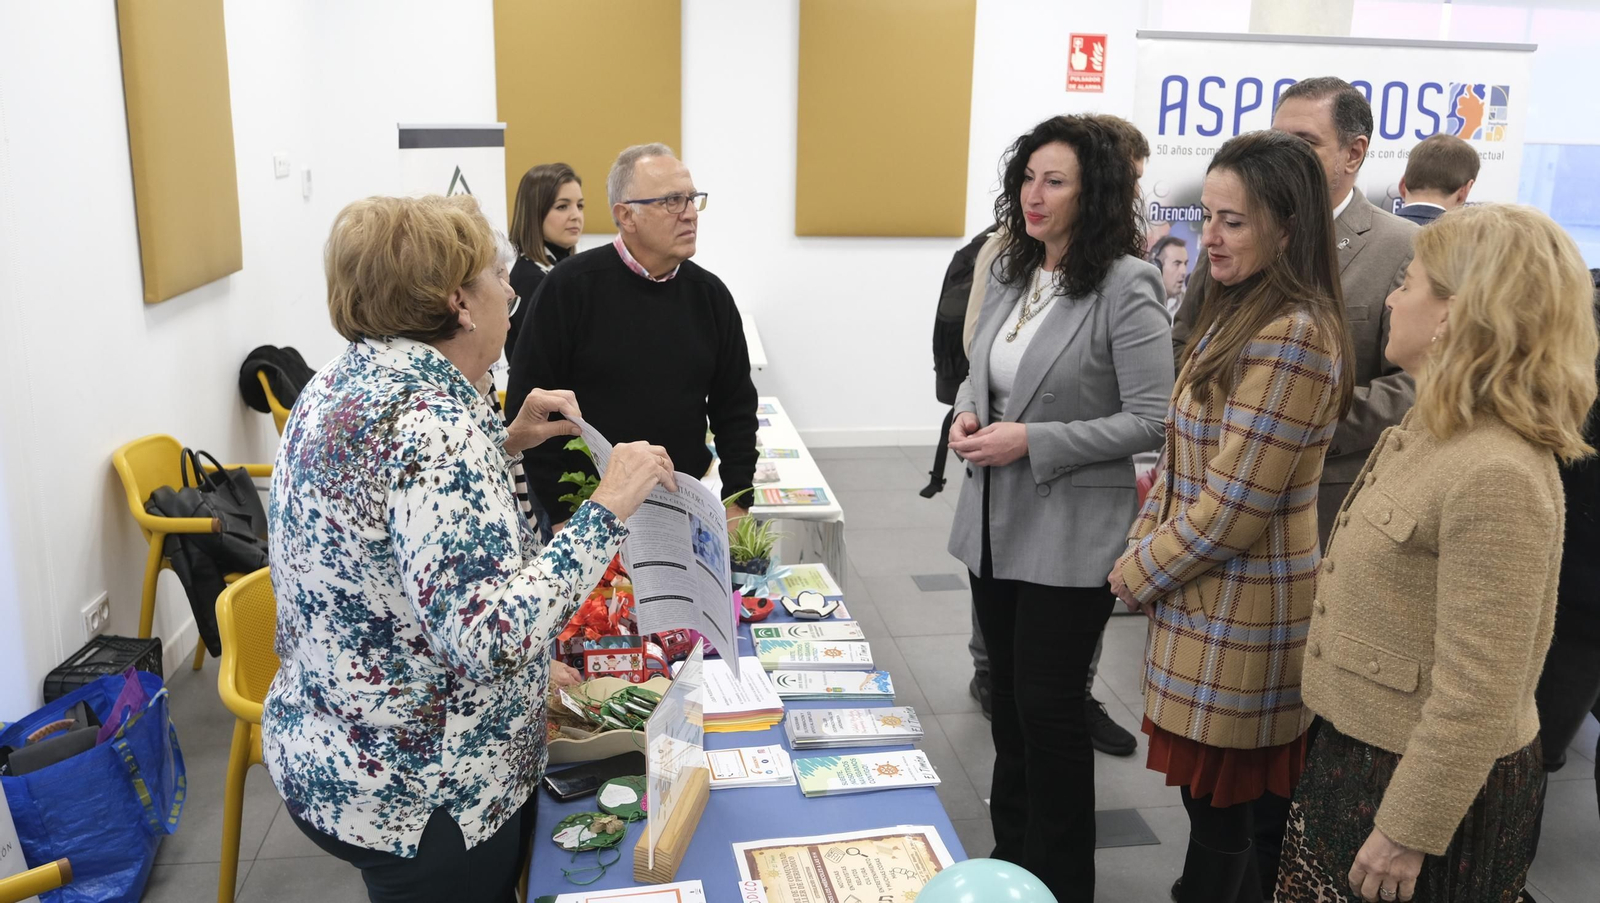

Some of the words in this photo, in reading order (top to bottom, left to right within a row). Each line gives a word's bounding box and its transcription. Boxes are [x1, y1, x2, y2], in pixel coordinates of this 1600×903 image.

[1158, 75, 1443, 140] ASPOS
[1156, 144, 1168, 155] 50
[1170, 144, 1192, 156] años
[1378, 151, 1394, 159] con
[1479, 150, 1504, 160] ectual
[834, 870, 844, 888] NOTICIAS
[841, 866, 856, 891] ENTREVISTAS
[852, 868, 862, 886] RELATOS
[860, 868, 872, 886] CULTURA
[865, 858, 884, 893] ENTRETENIMIENTO
